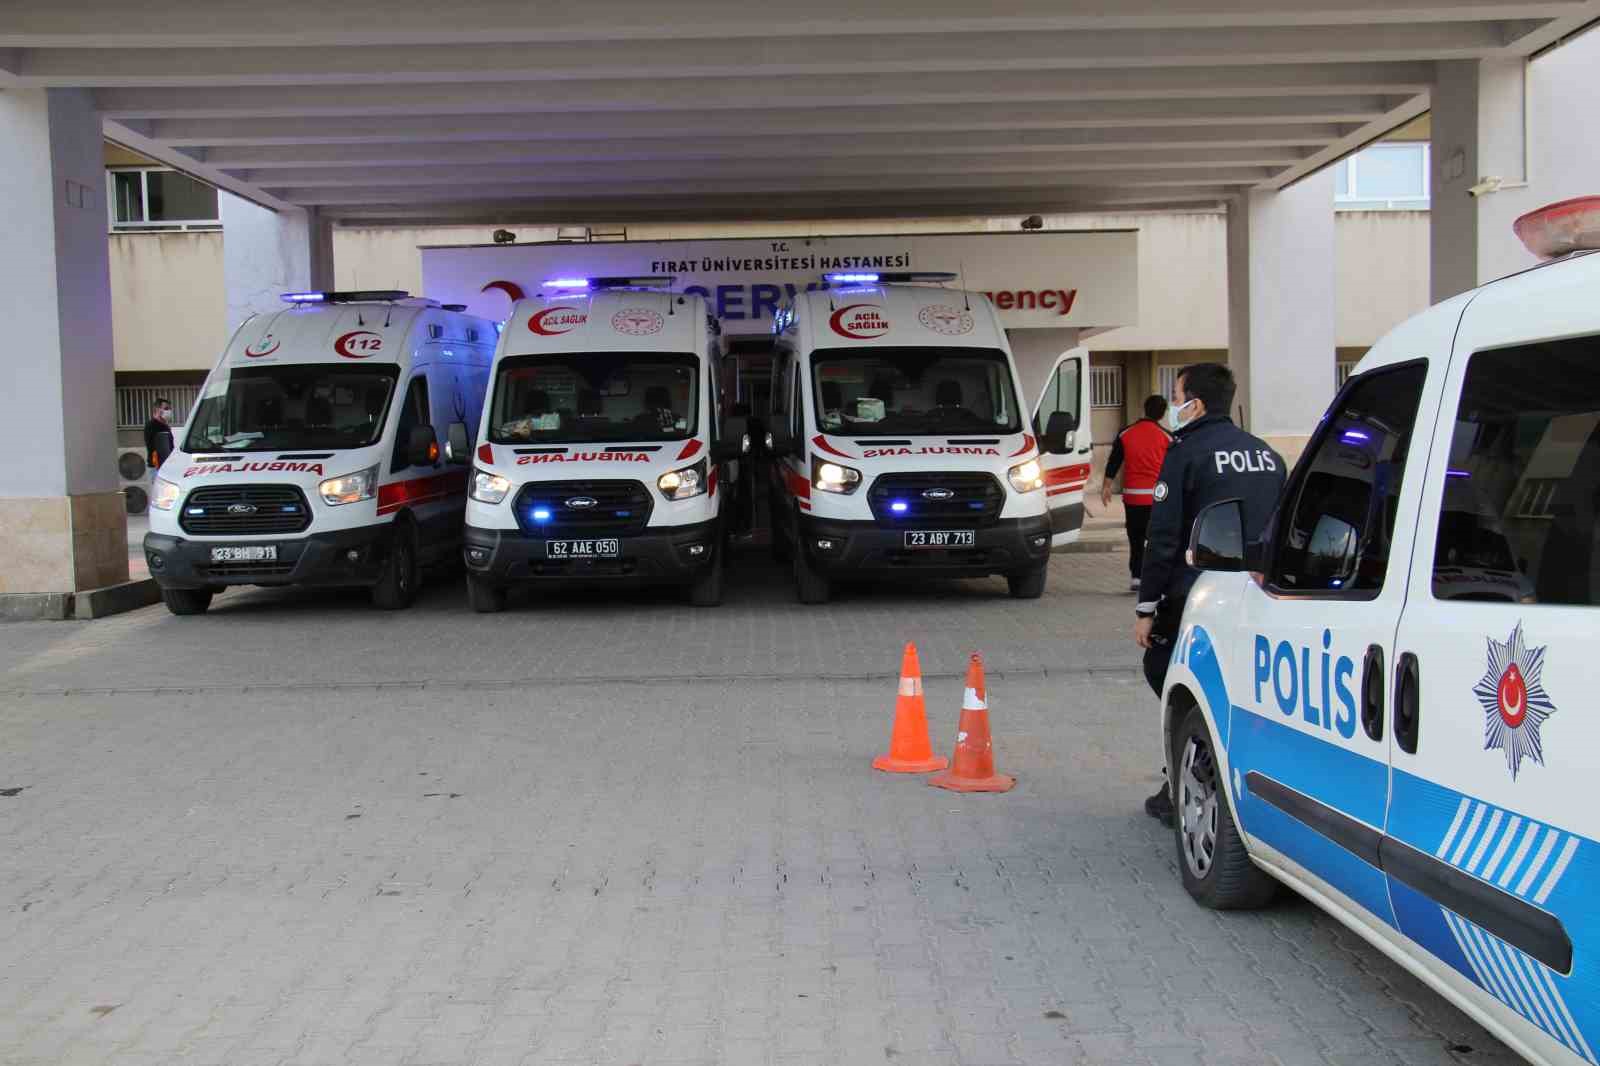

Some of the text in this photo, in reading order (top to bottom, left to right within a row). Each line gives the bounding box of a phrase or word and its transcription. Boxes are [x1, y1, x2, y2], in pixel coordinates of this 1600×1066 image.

[771, 242, 790, 252] T.C.
[652, 252, 910, 273] FIRAT ÜNİVERSİTESİ HASTANESİ
[985, 288, 1078, 316] ency
[348, 339, 382, 350] 112
[912, 532, 973, 545] 23 ABY 713
[553, 541, 616, 554] 62 AAE 050
